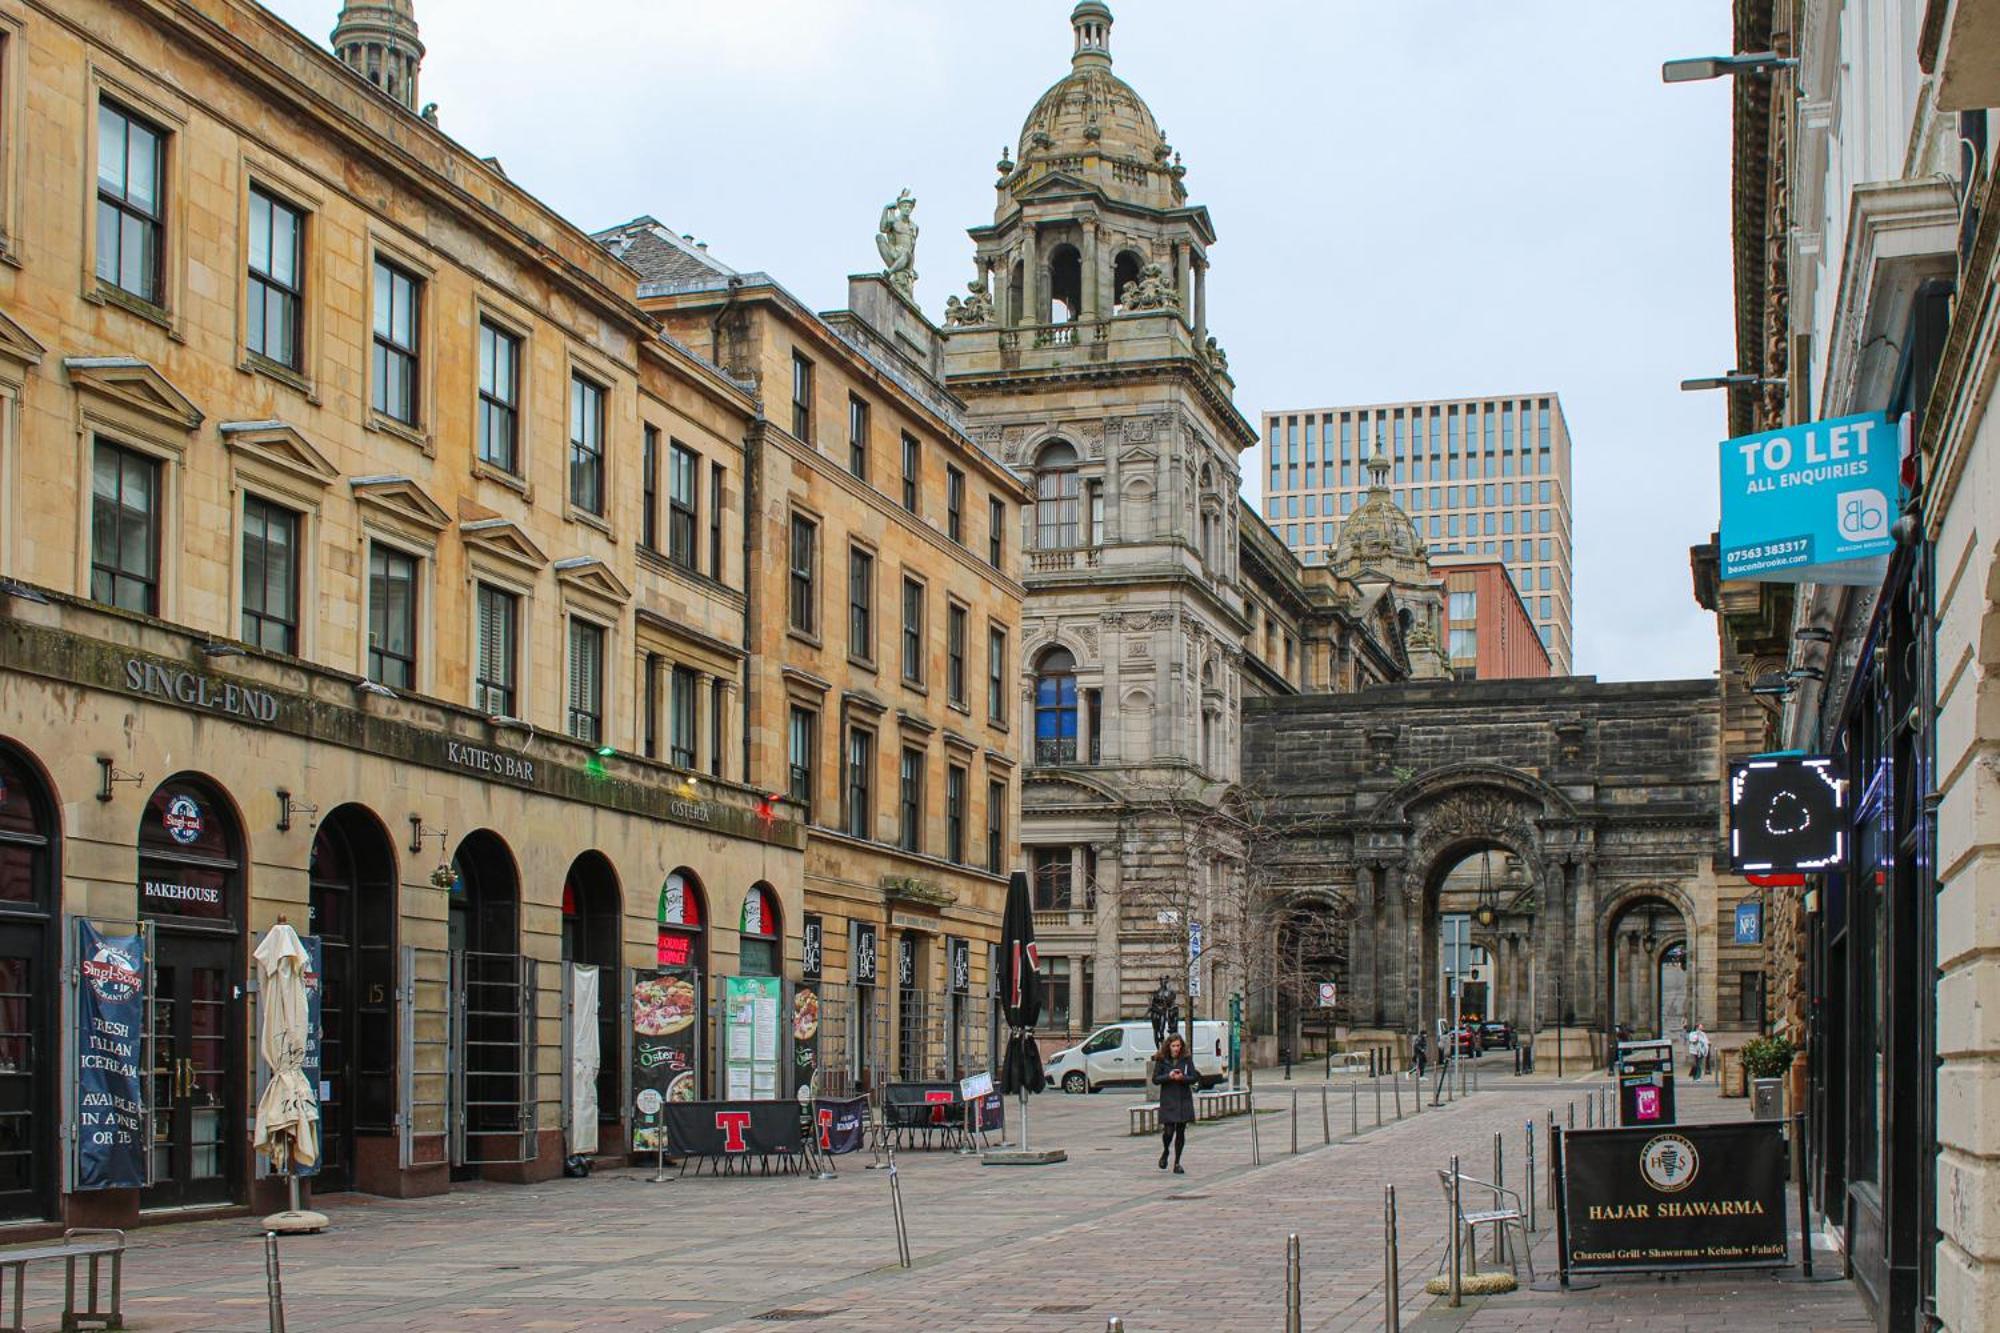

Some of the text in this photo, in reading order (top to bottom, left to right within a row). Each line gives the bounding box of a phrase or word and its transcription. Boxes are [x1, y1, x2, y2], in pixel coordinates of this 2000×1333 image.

[1739, 421, 1875, 475] TO LET
[1746, 460, 1868, 494] ALL ENQUIRIES
[1727, 539, 1808, 563] 07563 383317
[126, 659, 279, 722] SINGL-END
[448, 742, 534, 782] KATIE'S BAR
[145, 882, 219, 903] BAKEHOUSE
[83, 960, 142, 992] Singl-Scoop
[641, 1050, 686, 1066] Osteria
[81, 1112, 99, 1125] IN
[105, 1112, 115, 1125] A
[93, 1131, 113, 1144] OR
[715, 1111, 751, 1152] T
[1651, 1152, 1662, 1168] H
[1589, 1200, 1765, 1221] HAJAR SHAWARMA
[1573, 1243, 1784, 1261] Charcoal Grill Shawarma Kebabs Falafel
